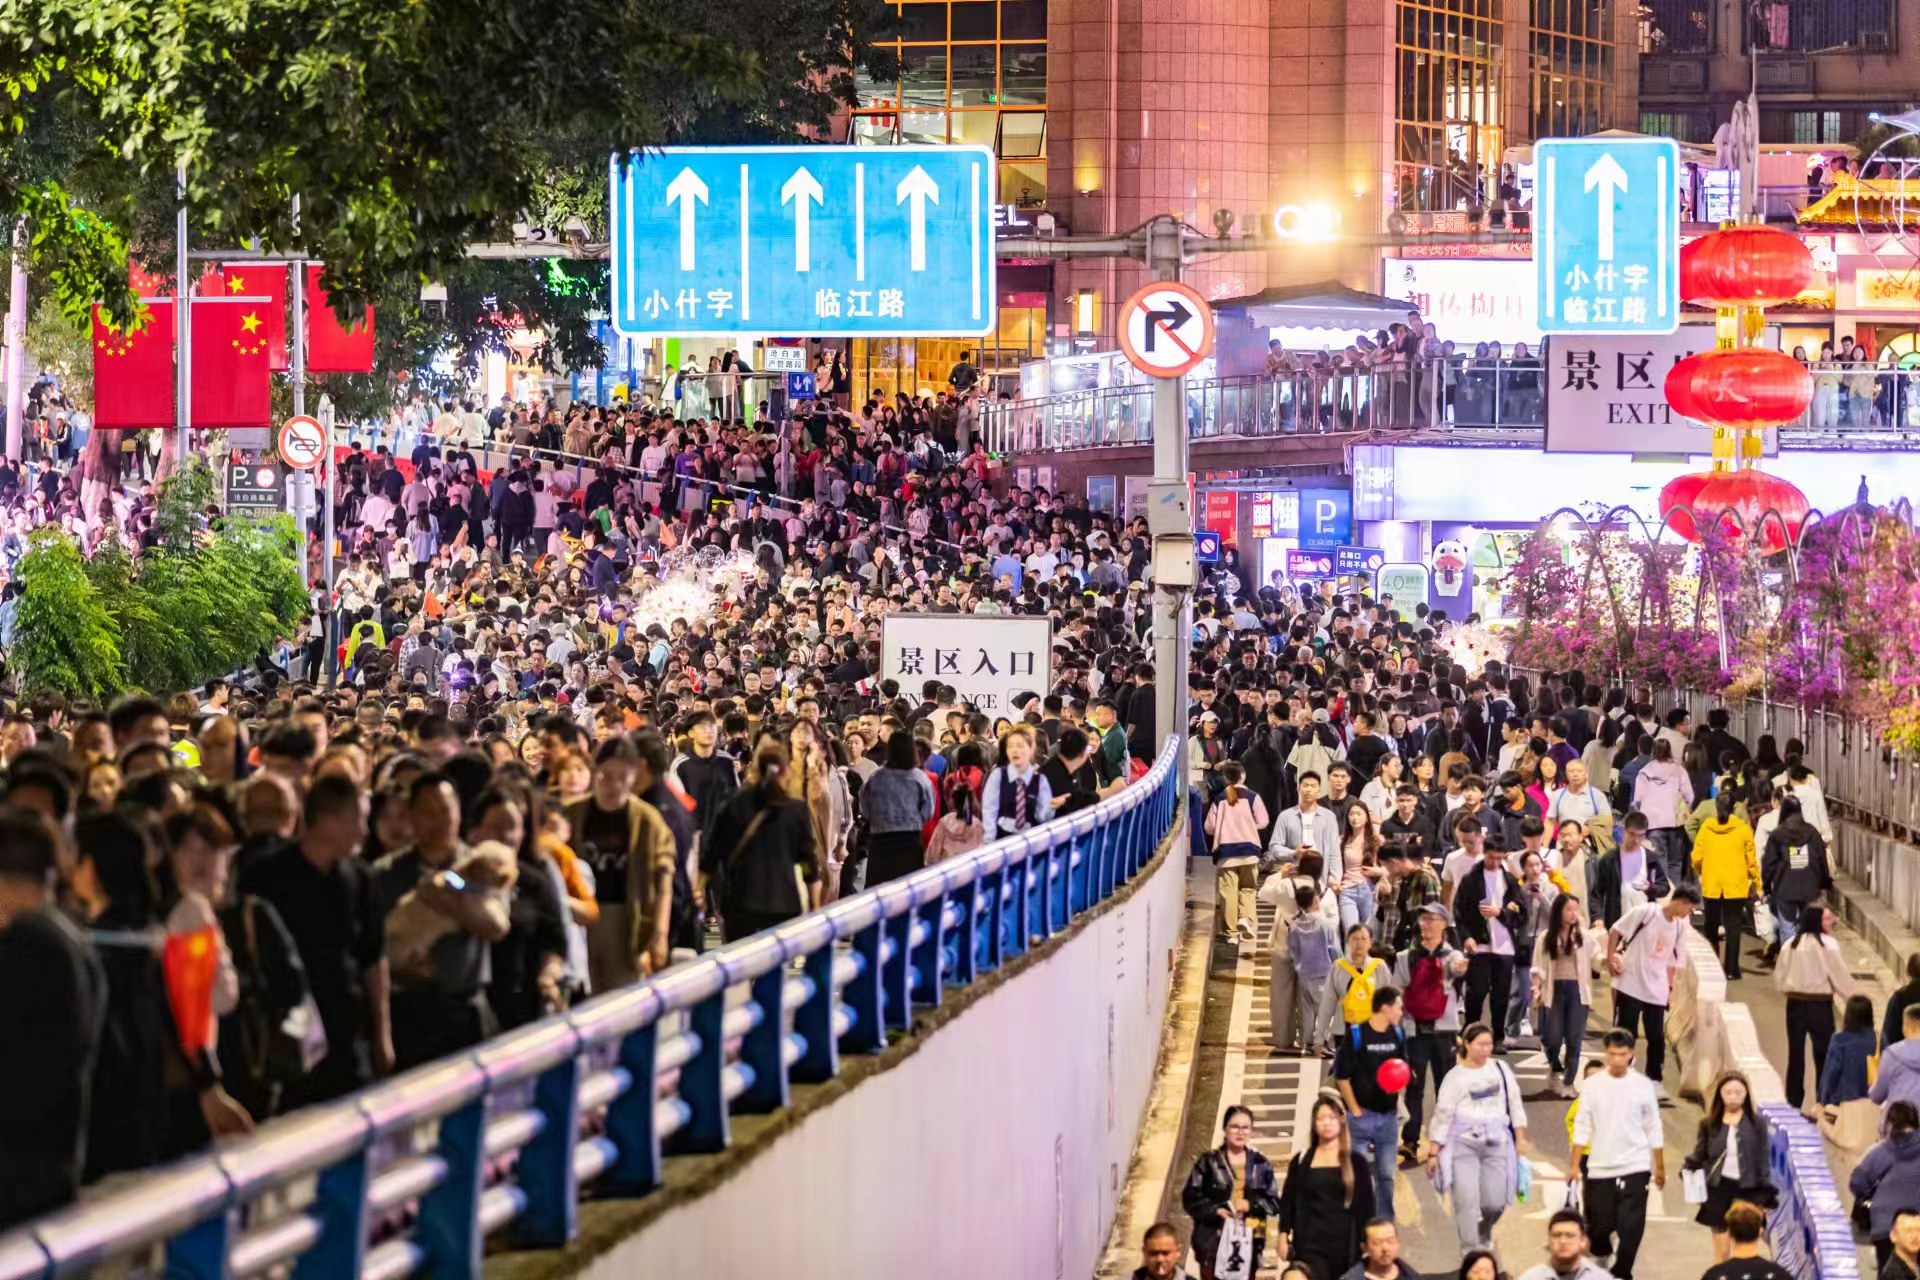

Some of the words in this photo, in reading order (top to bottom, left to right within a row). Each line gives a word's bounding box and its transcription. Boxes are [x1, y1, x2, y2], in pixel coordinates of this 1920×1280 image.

[1564, 263, 1649, 292] 小什字
[643, 288, 734, 319] 小什字
[815, 288, 906, 319] 临江路
[1563, 296, 1647, 324] 临江路
[1561, 350, 1695, 392] 景区
[1606, 403, 1673, 425] EXIT
[232, 466, 249, 487] P
[1315, 499, 1337, 534] P
[897, 646, 1035, 677] 景区入口
